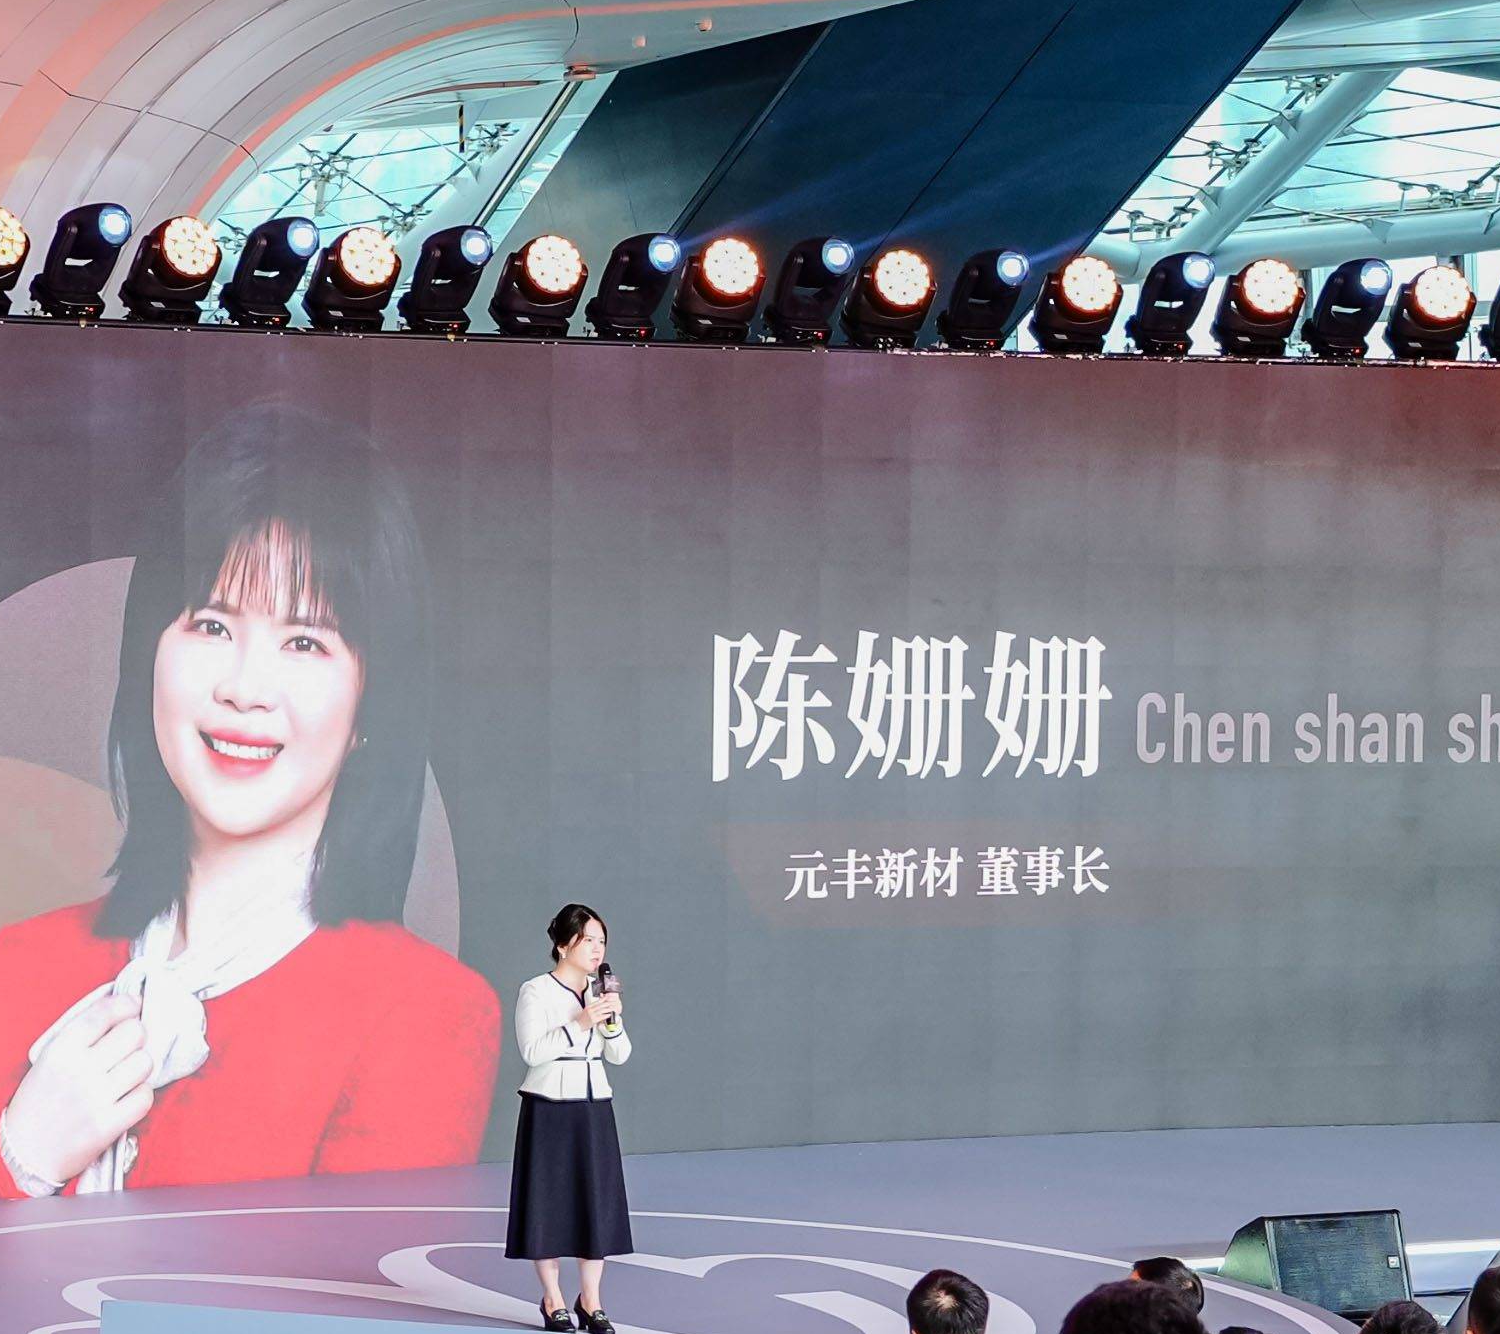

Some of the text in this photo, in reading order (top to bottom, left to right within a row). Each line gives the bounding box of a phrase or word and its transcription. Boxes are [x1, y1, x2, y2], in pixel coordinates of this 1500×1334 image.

[712, 628, 1113, 783] 陈姗姗
[1136, 691, 1271, 764] Chen
[1294, 692, 1424, 764] shan
[783, 845, 1110, 902] 元丰新材 董事长
